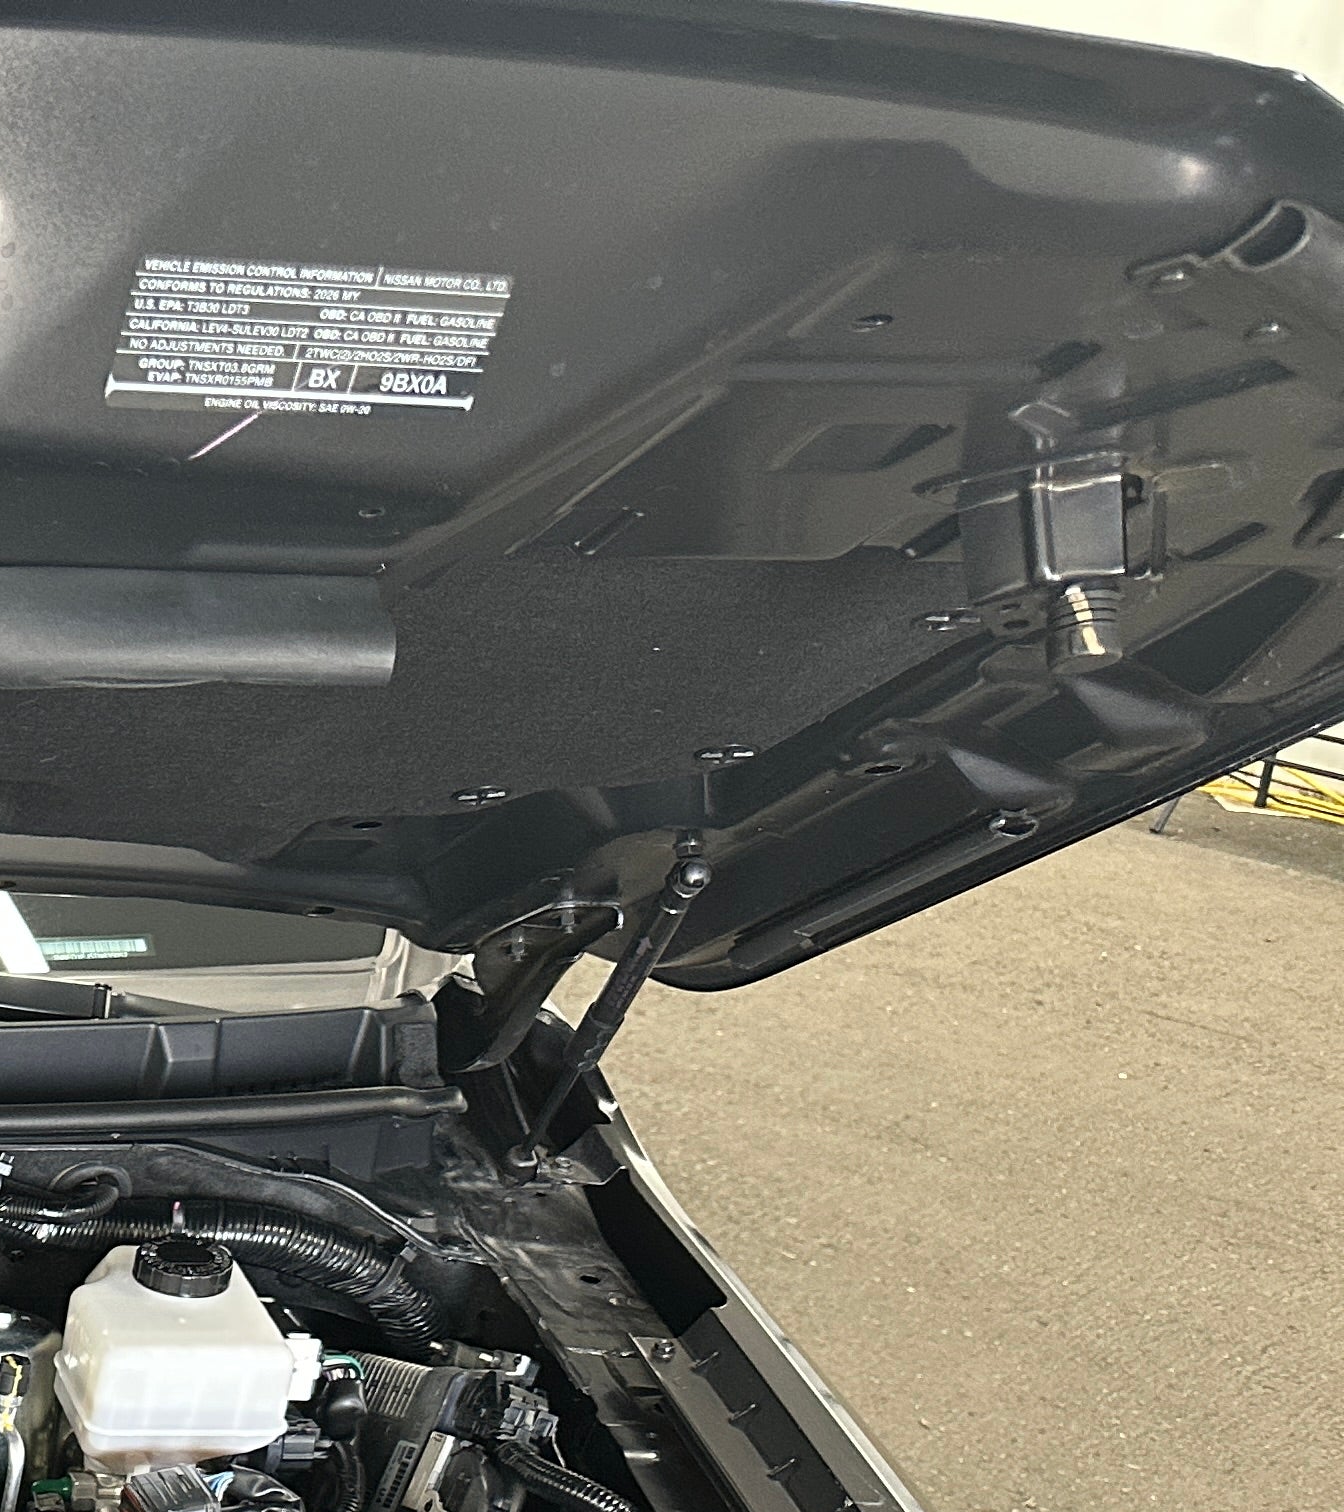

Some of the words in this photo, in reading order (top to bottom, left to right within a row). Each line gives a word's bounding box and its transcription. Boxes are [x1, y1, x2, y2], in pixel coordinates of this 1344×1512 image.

[144, 258, 191, 273] VEHICLE
[192, 261, 245, 276] EMISSION
[246, 264, 298, 279] CONTROL
[299, 268, 374, 284] INFORMATION
[382, 273, 423, 287] NISSAN
[423, 276, 462, 289] MOTOR
[138, 277, 207, 292] CONFORMS
[209, 281, 226, 294] TO
[226, 283, 311, 299] REGULATIONS:
[313, 288, 340, 300] 2026
[134, 298, 155, 311] U.S.
[158, 300, 184, 312] EPA:
[187, 301, 220, 314] T3B30
[221, 303, 250, 315] LDT3
[128, 318, 200, 333] CALIFORNIA:
[201, 322, 280, 338] LEV4-SULEV30
[280, 326, 310, 339] LDT2
[319, 308, 347, 321] OBD:
[349, 310, 365, 322] CA
[367, 311, 392, 324] OBD
[439, 316, 497, 330] GASOLINE
[129, 337, 148, 350] NO
[149, 339, 235, 355] ADJUSTMENTS
[236, 342, 285, 357] NEEDED.
[313, 327, 342, 340] OBD:
[343, 329, 360, 341] CA
[361, 330, 385, 343] OBD
[432, 335, 489, 349] GASOLINE
[138, 356, 186, 371] GROUP:
[147, 370, 183, 384] EVAP:
[307, 367, 342, 389] BX
[378, 371, 448, 395] 9BX0A
[204, 396, 243, 409] ENGINE
[243, 398, 261, 410] OIL
[261, 400, 317, 413] VISCOSITY:
[318, 402, 340, 413] SAE
